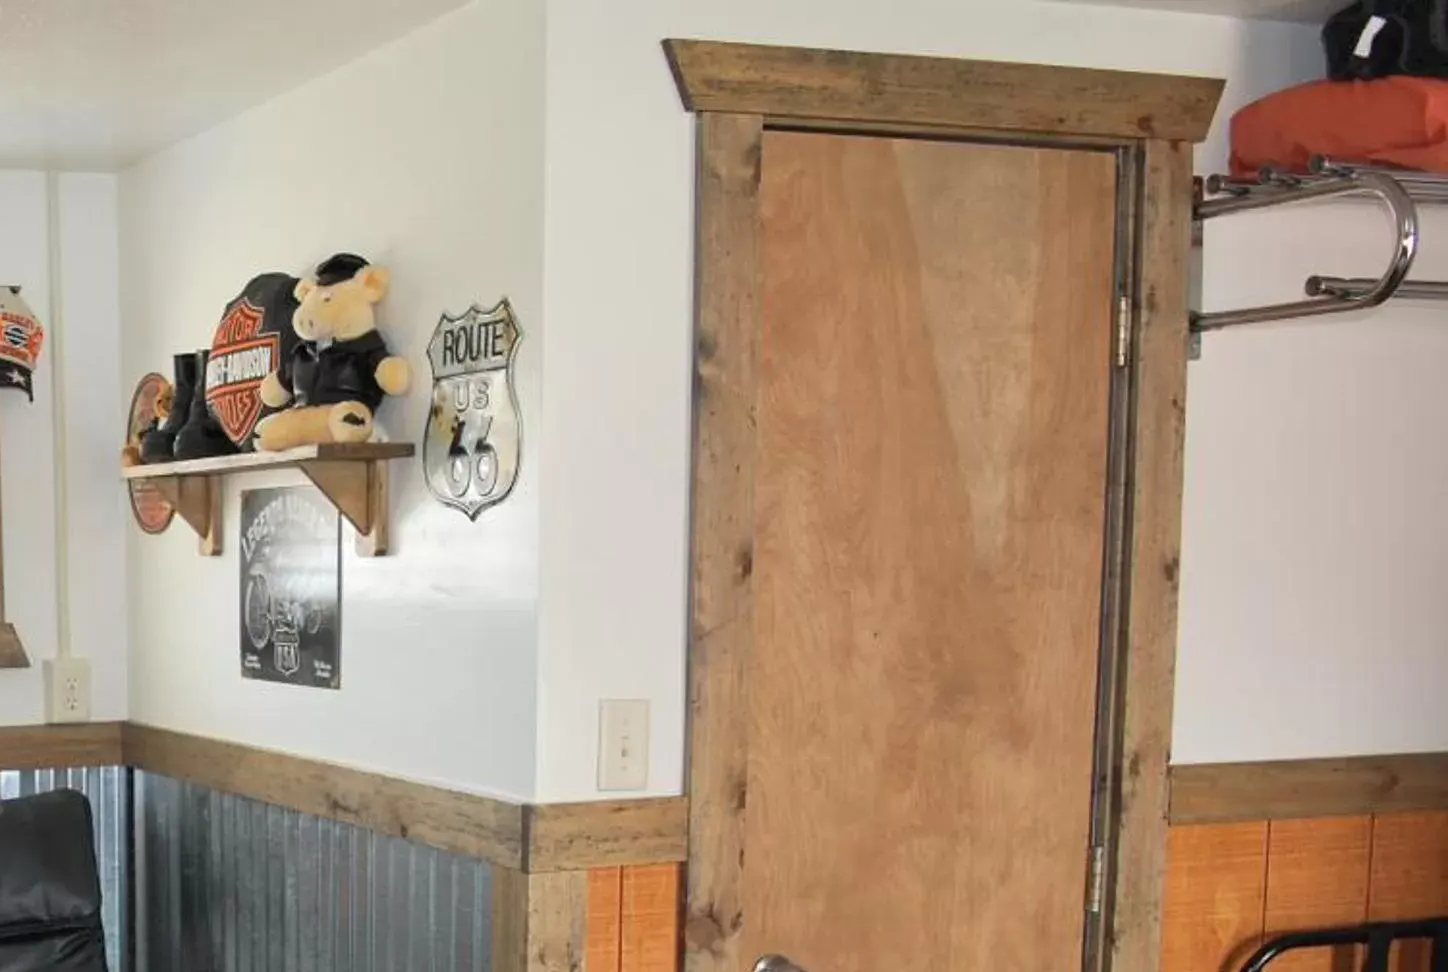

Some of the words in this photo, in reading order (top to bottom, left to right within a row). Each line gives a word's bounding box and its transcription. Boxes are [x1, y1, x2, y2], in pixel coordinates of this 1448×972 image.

[442, 319, 505, 368] ROUTE
[454, 381, 490, 413] US
[448, 416, 499, 498] 66
